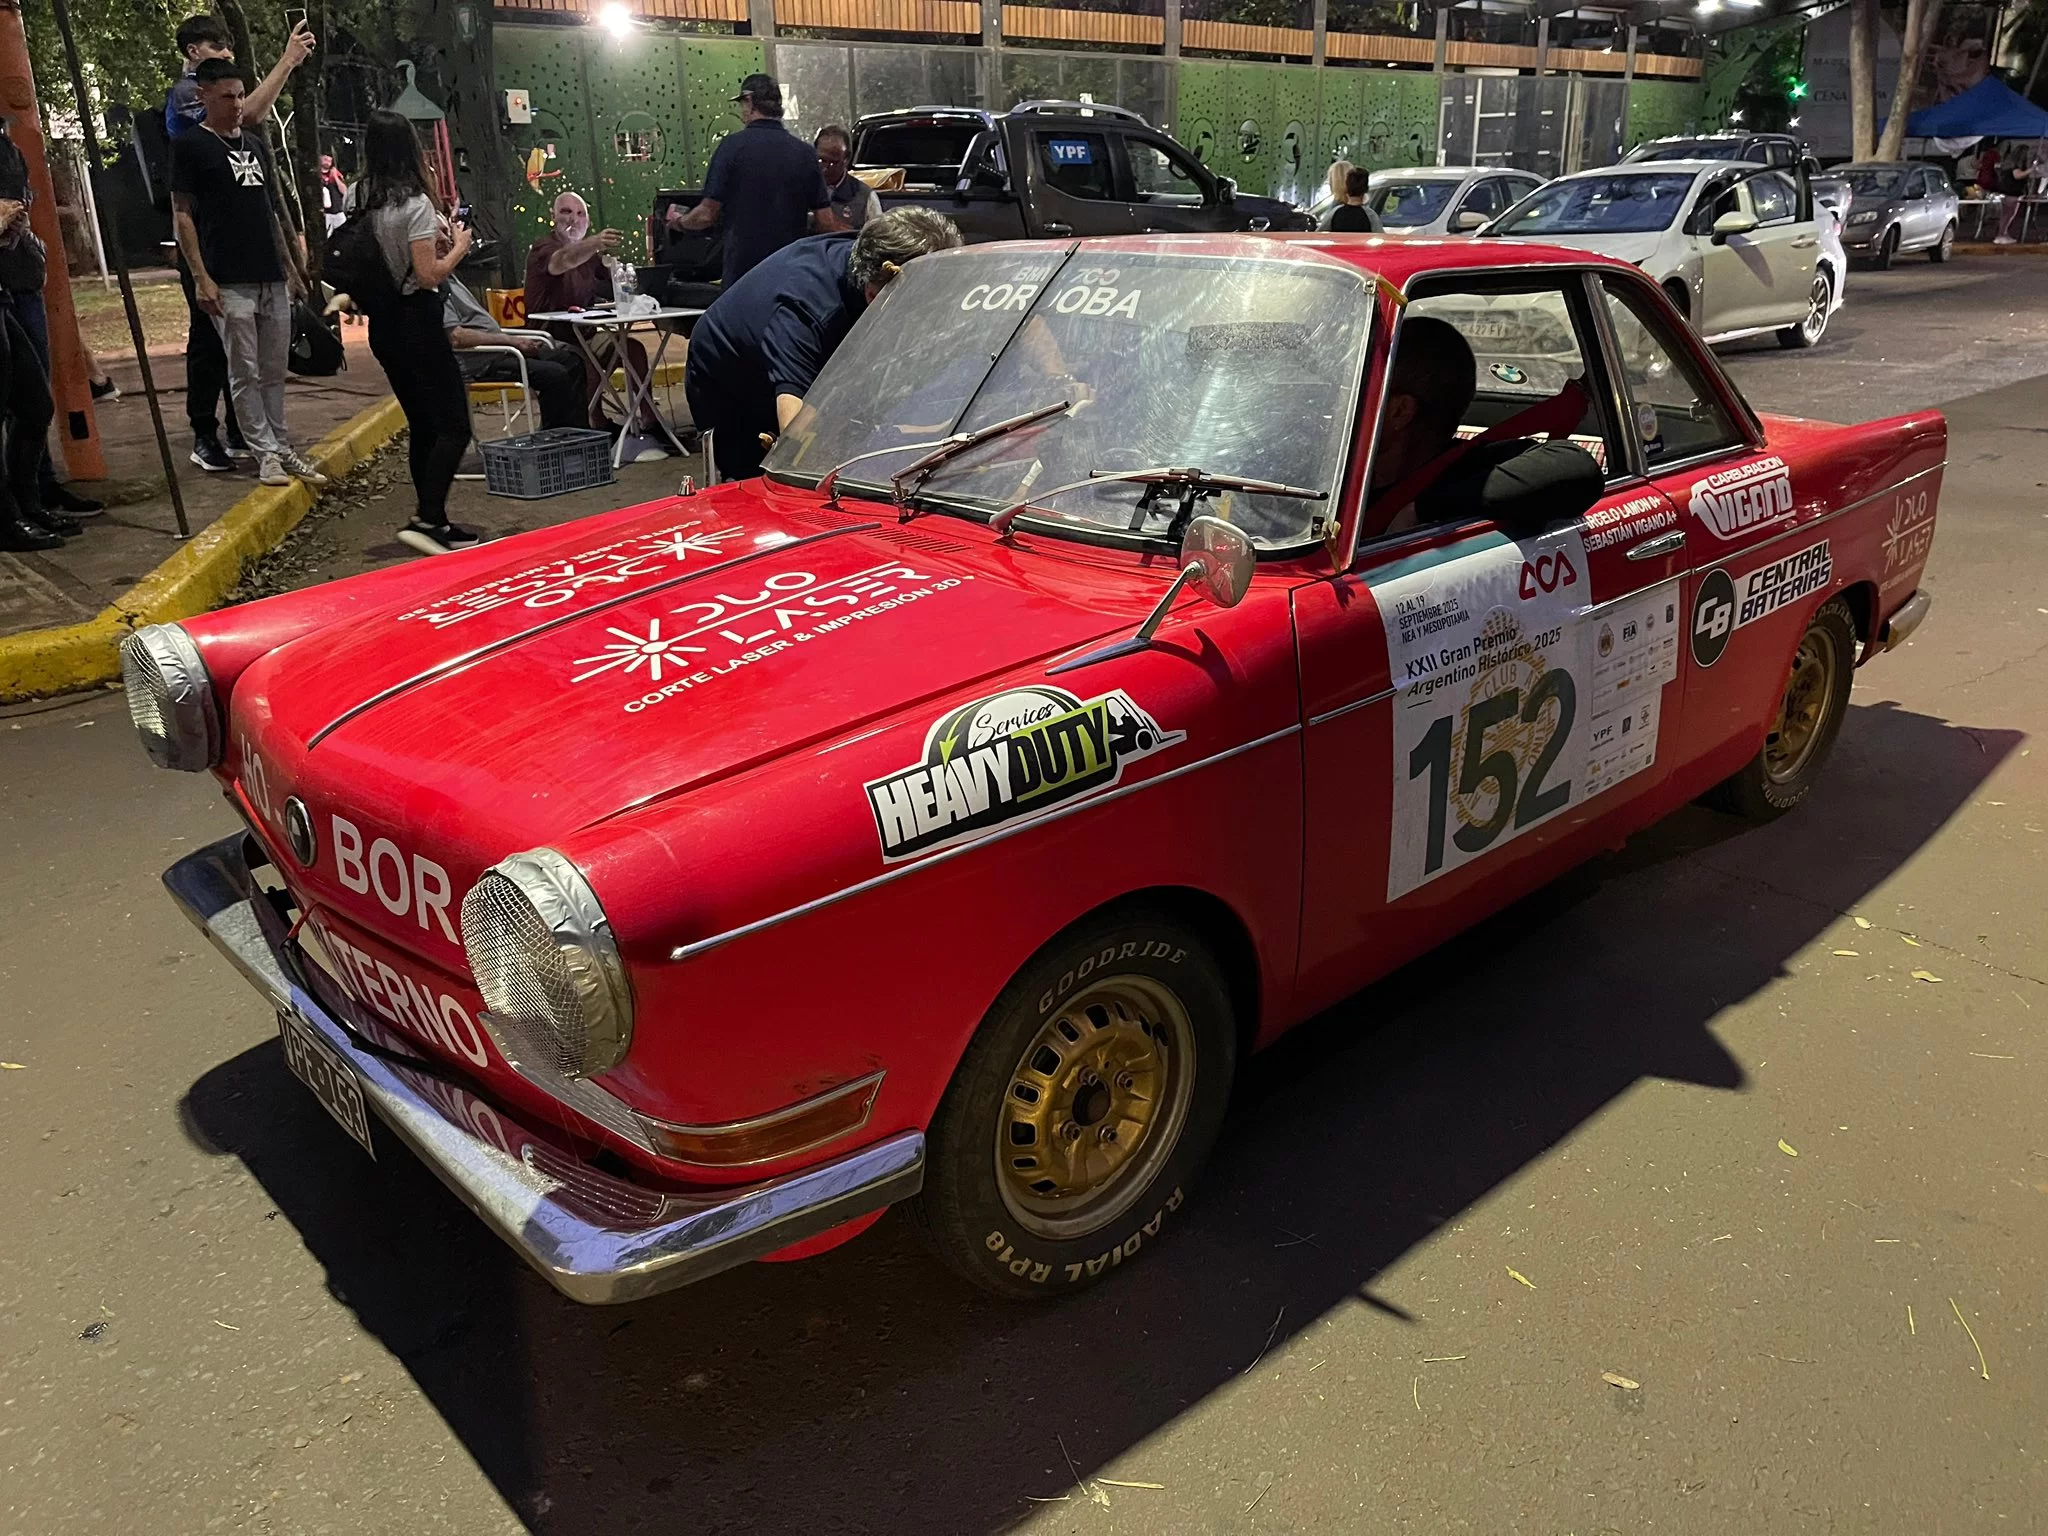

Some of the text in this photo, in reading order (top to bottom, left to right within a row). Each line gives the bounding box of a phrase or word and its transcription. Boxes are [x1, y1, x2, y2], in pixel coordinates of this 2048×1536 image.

[1053, 145, 1086, 159] YPF
[961, 284, 1142, 319] COROBA
[1708, 455, 1784, 487] CARBURACION
[1617, 497, 1652, 519] LAMON
[1583, 521, 1633, 553] SEBASTIÁN
[1632, 512, 1666, 536] VIGANO
[1519, 551, 1577, 601] ACA
[1738, 562, 1833, 625] BATERIAS
[1747, 545, 1831, 596] CENTRAL
[718, 566, 932, 645] LASER
[1396, 595, 1425, 616] 12 AL 19
[1399, 605, 1442, 630] SEPTIEMBRE
[1402, 609, 1470, 645] NEA Y MESOPOTAMIA
[623, 577, 962, 713] CORTE LASER & IMPRESIÓN 3D
[1405, 626, 1517, 680] XXII Gran Premio
[1623, 623, 1637, 641] FIA
[1407, 626, 1563, 698] Argentino Histórico 2025
[1484, 663, 1517, 699] CLUB
[973, 702, 1056, 748] Services
[1593, 725, 1613, 742] YPF
[1410, 668, 1577, 876] 152
[332, 813, 461, 946] BOR
[1038, 940, 1187, 1014] GOODRIDE
[323, 1060, 366, 1142] 153
[1064, 1186, 1185, 1283] RADIAL
